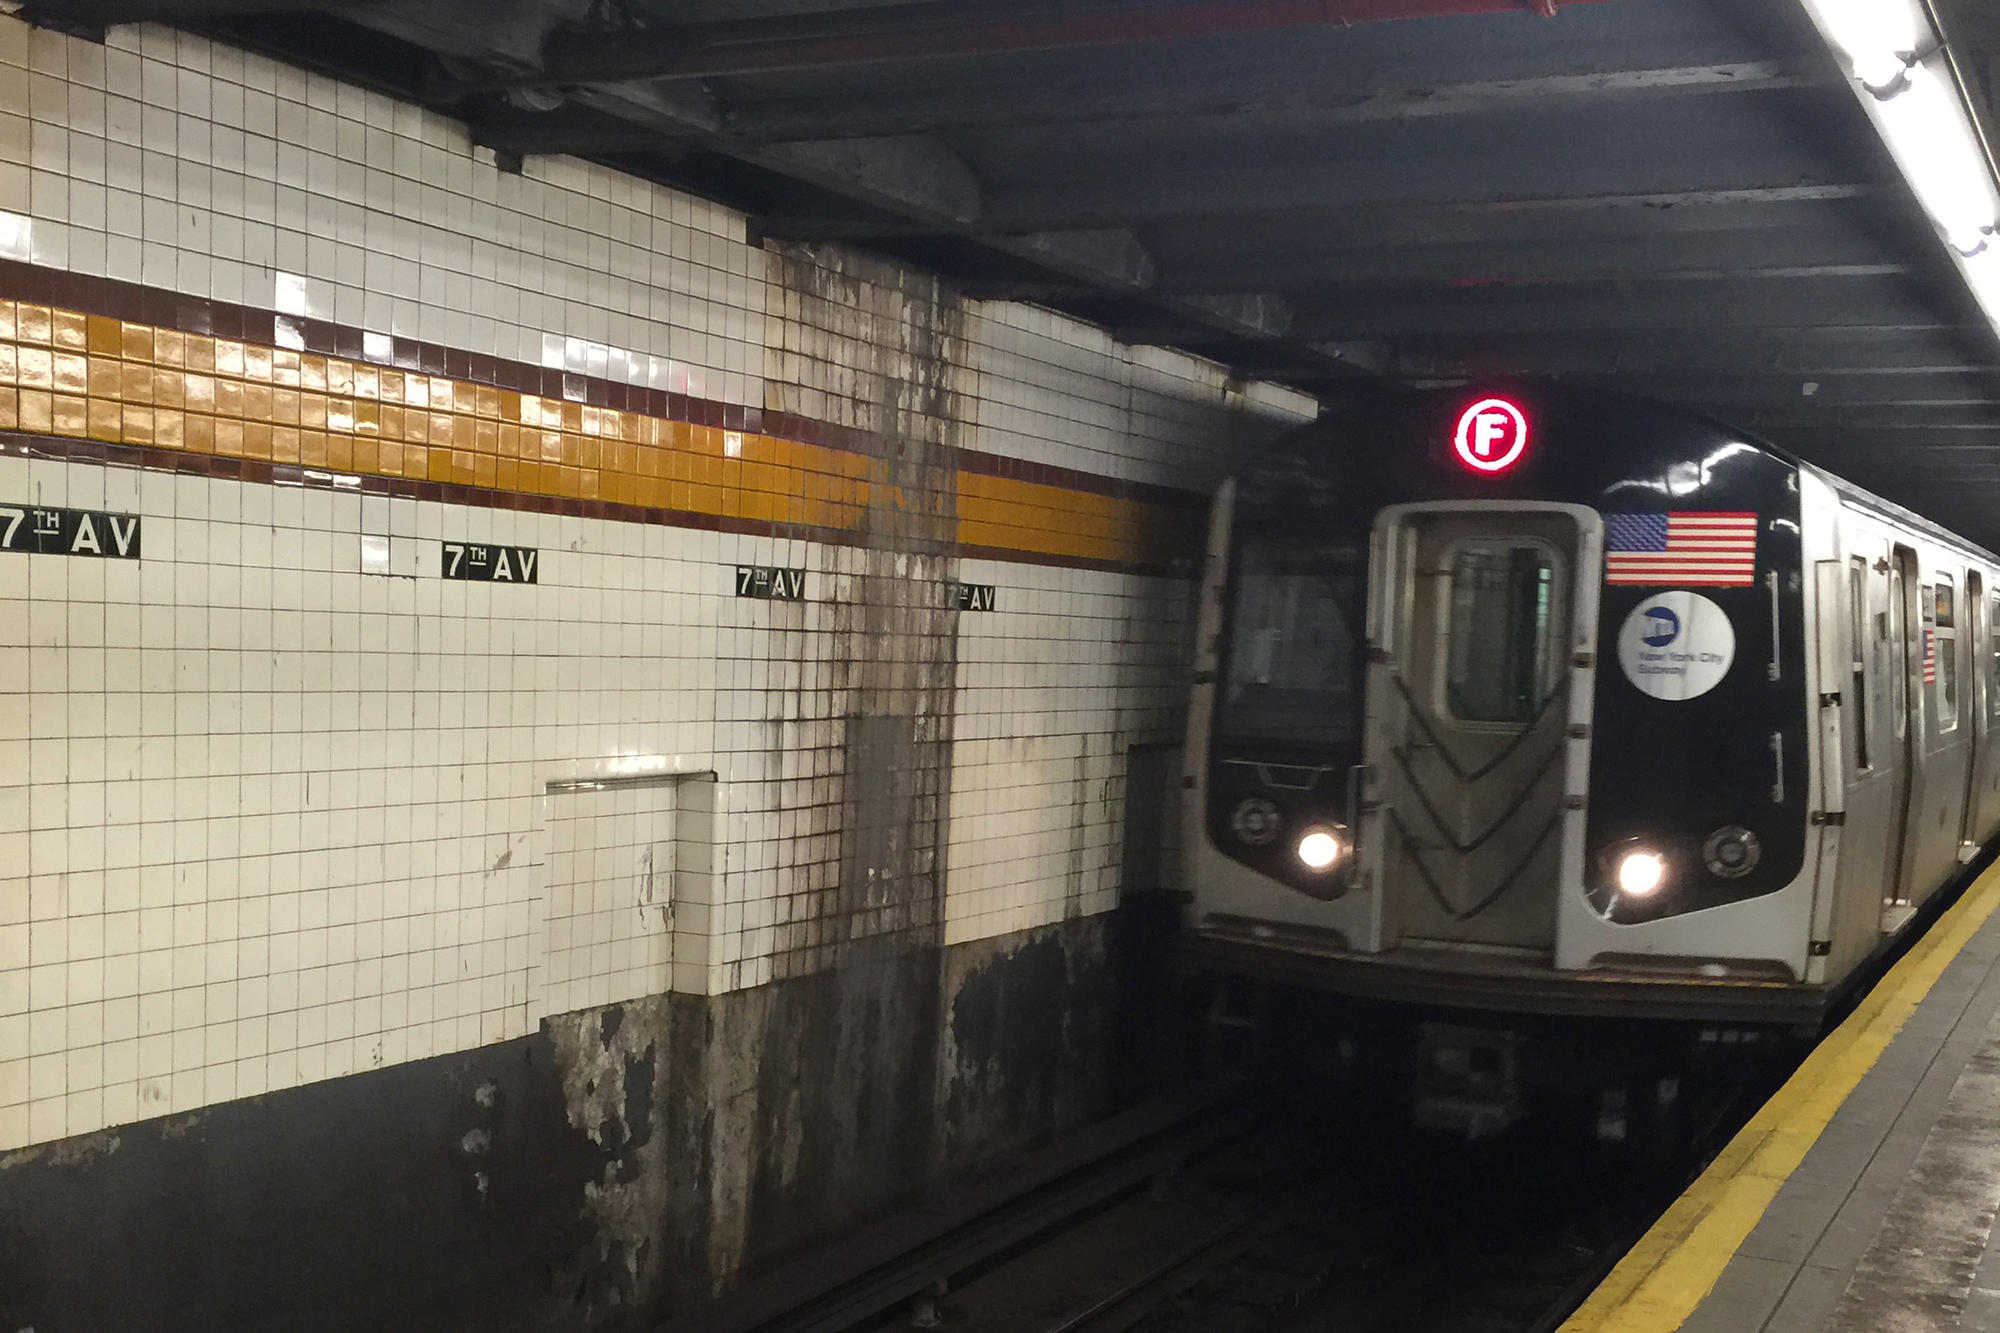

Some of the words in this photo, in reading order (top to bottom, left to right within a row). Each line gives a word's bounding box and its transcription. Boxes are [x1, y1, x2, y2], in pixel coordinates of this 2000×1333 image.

[1475, 413, 1508, 456] F
[0, 507, 59, 548] 7TH
[71, 513, 137, 556] AV
[445, 544, 487, 577] 7TH
[493, 548, 536, 582] AV
[738, 567, 768, 595] 7TH
[771, 569, 802, 598] AV
[970, 586, 993, 610] AV
